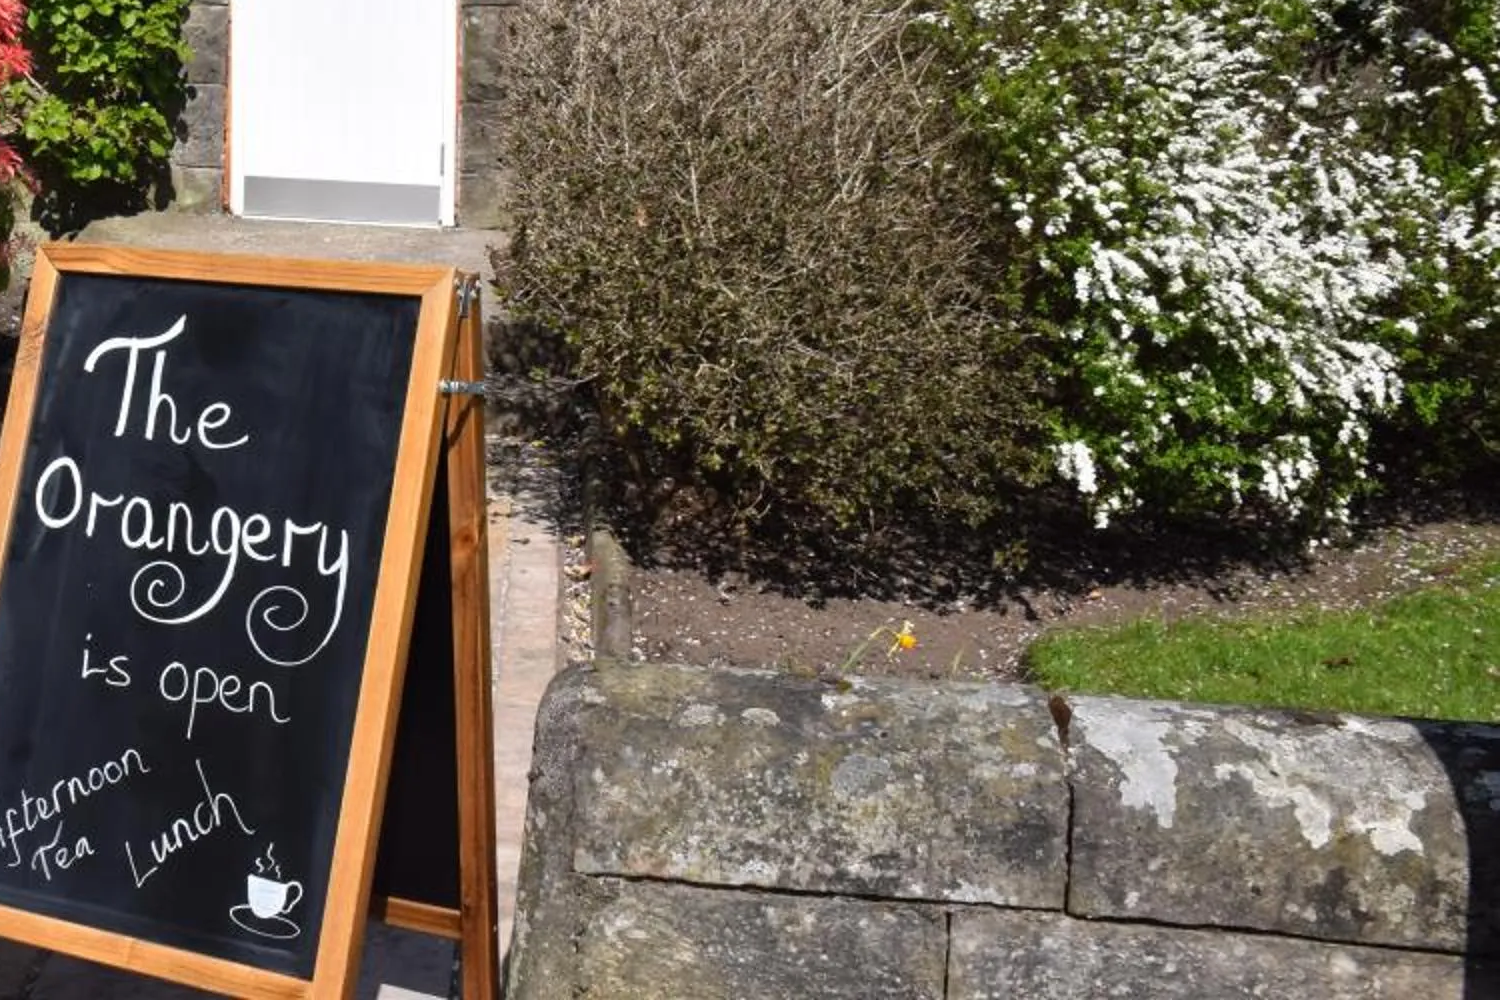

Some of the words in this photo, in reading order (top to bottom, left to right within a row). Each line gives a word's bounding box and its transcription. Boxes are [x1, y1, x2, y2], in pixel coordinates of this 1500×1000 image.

[84, 313, 249, 449] The
[34, 455, 350, 667] Orangery
[80, 632, 132, 687] is
[158, 661, 291, 740] open
[30, 821, 96, 881] Tea
[125, 760, 256, 888] Lunch
